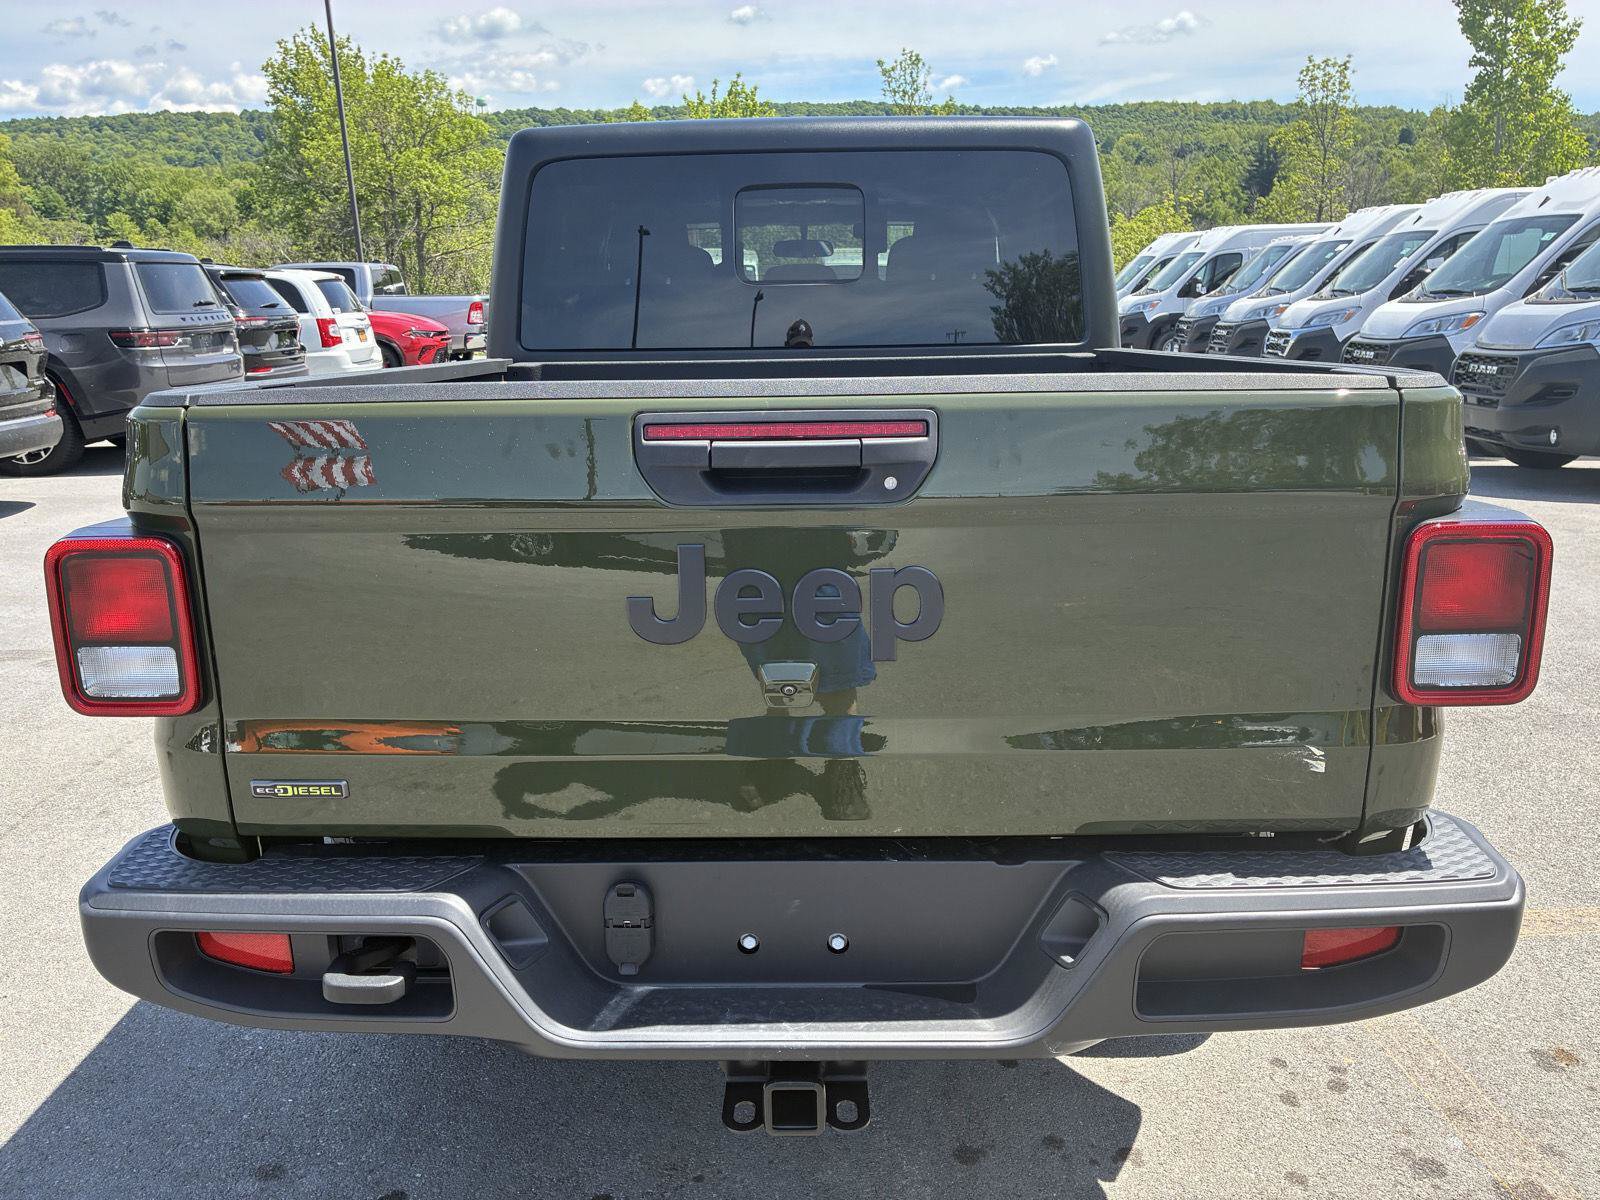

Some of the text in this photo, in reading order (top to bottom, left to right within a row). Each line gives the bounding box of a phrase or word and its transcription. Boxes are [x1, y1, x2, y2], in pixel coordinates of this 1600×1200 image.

[1353, 349, 1375, 359] RAM
[1468, 363, 1498, 375] RAM
[626, 543, 945, 662] Jeep
